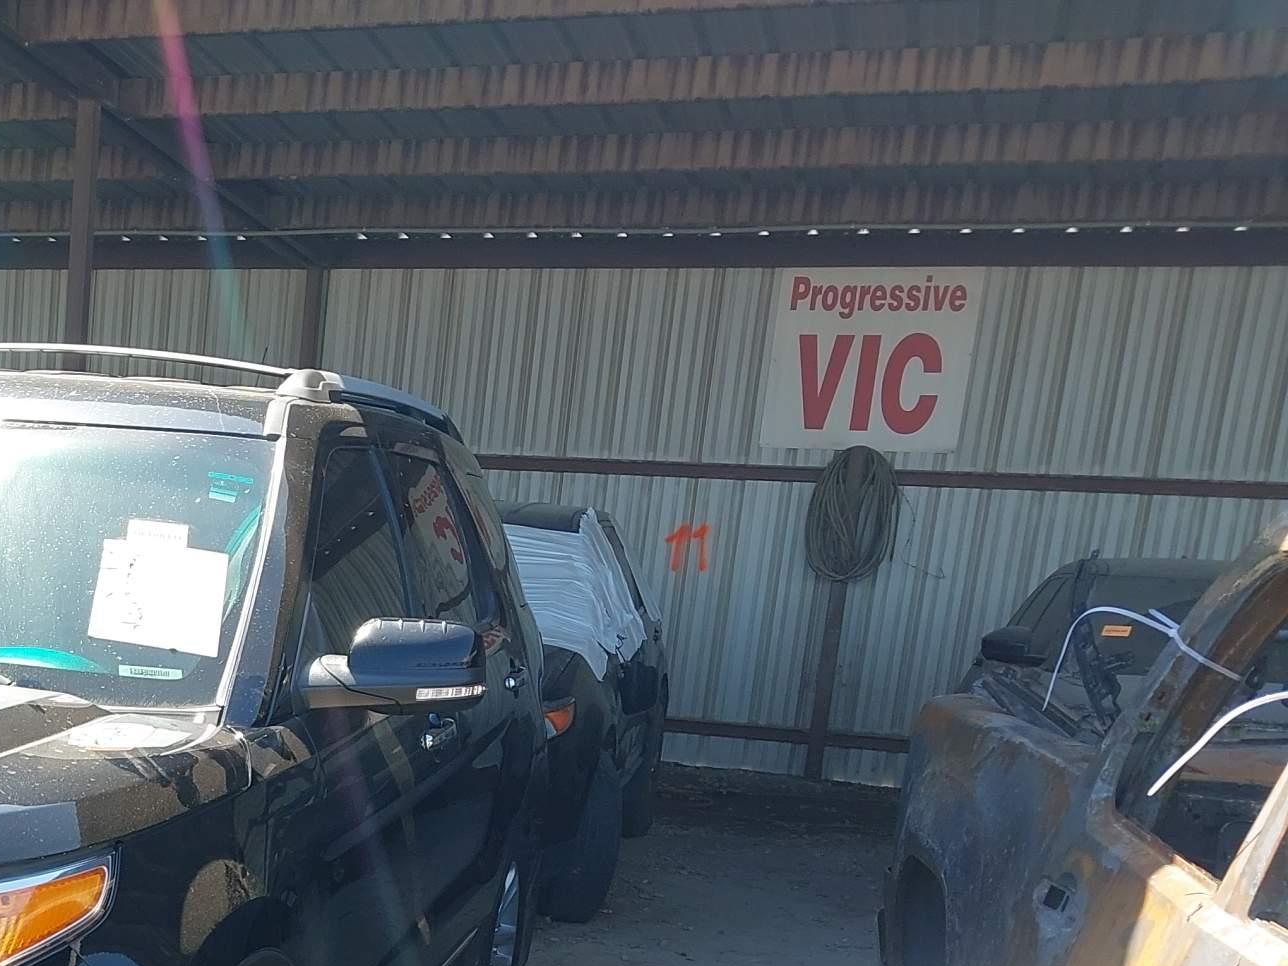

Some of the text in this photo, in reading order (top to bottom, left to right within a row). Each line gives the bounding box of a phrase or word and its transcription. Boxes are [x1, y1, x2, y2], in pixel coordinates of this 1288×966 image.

[789, 275, 967, 319] Progressive
[798, 332, 943, 435] VIC
[665, 522, 712, 572] 11
